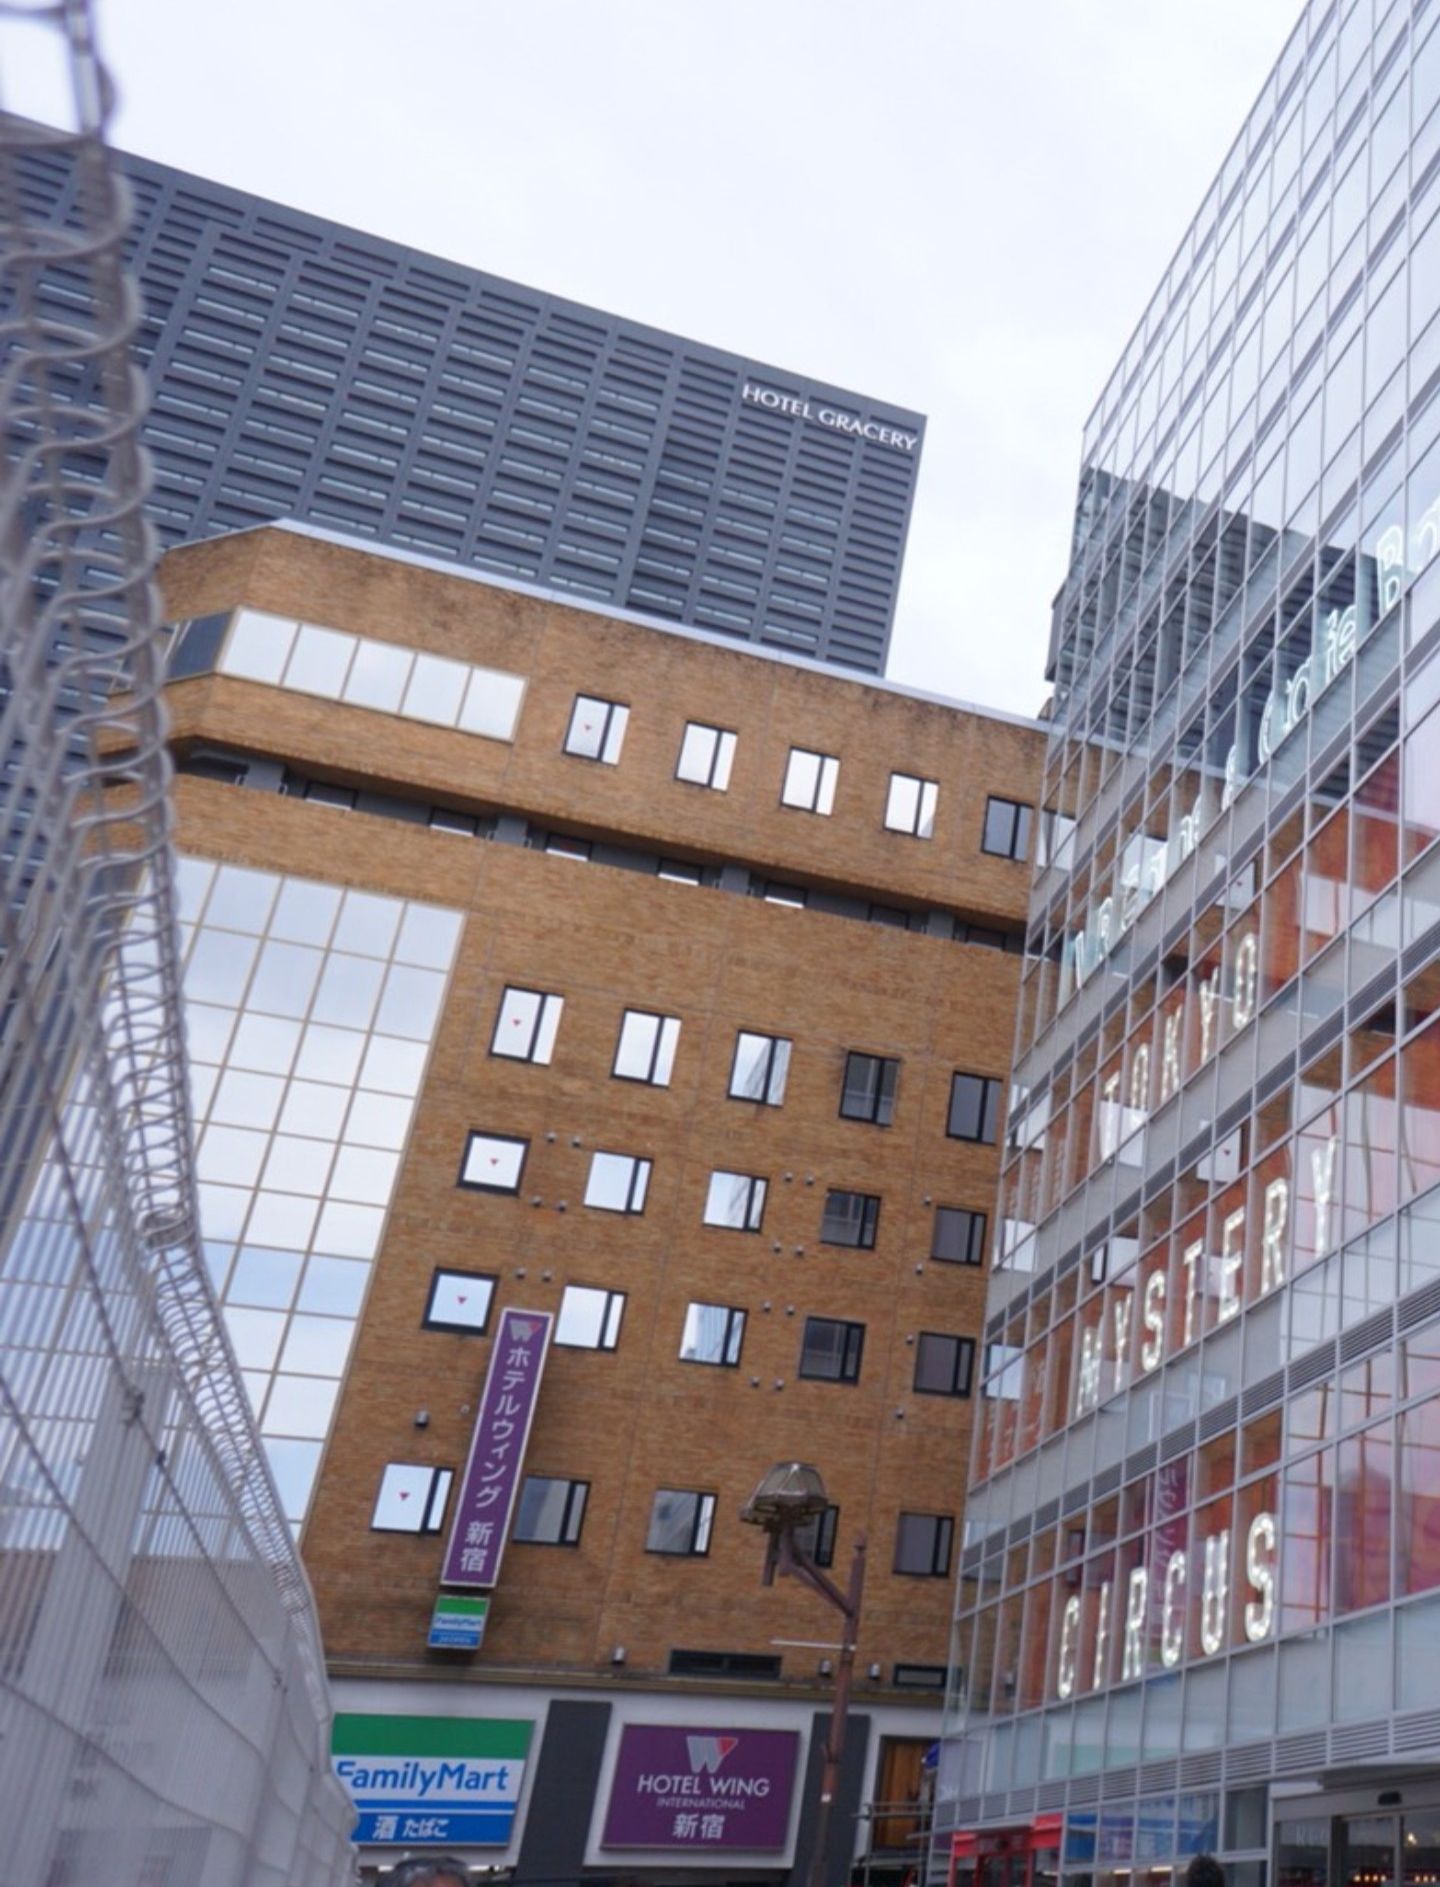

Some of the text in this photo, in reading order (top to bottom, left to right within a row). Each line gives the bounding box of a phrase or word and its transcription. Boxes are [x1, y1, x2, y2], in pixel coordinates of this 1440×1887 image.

[742, 383, 918, 451] HOTEL GRACERY
[1100, 932, 1258, 1166] TOKYO
[1076, 1135, 1342, 1419] MYSTERY
[460, 1346, 531, 1574] ホテルウィング 新宿
[1057, 1510, 1278, 1700] CIRCUS
[636, 1773, 771, 1798] HOTEL WING
[655, 1796, 746, 1811] INTERNATIONAL
[372, 1815, 451, 1841] 酒 たばこ
[672, 1811, 727, 1840] 新宿
